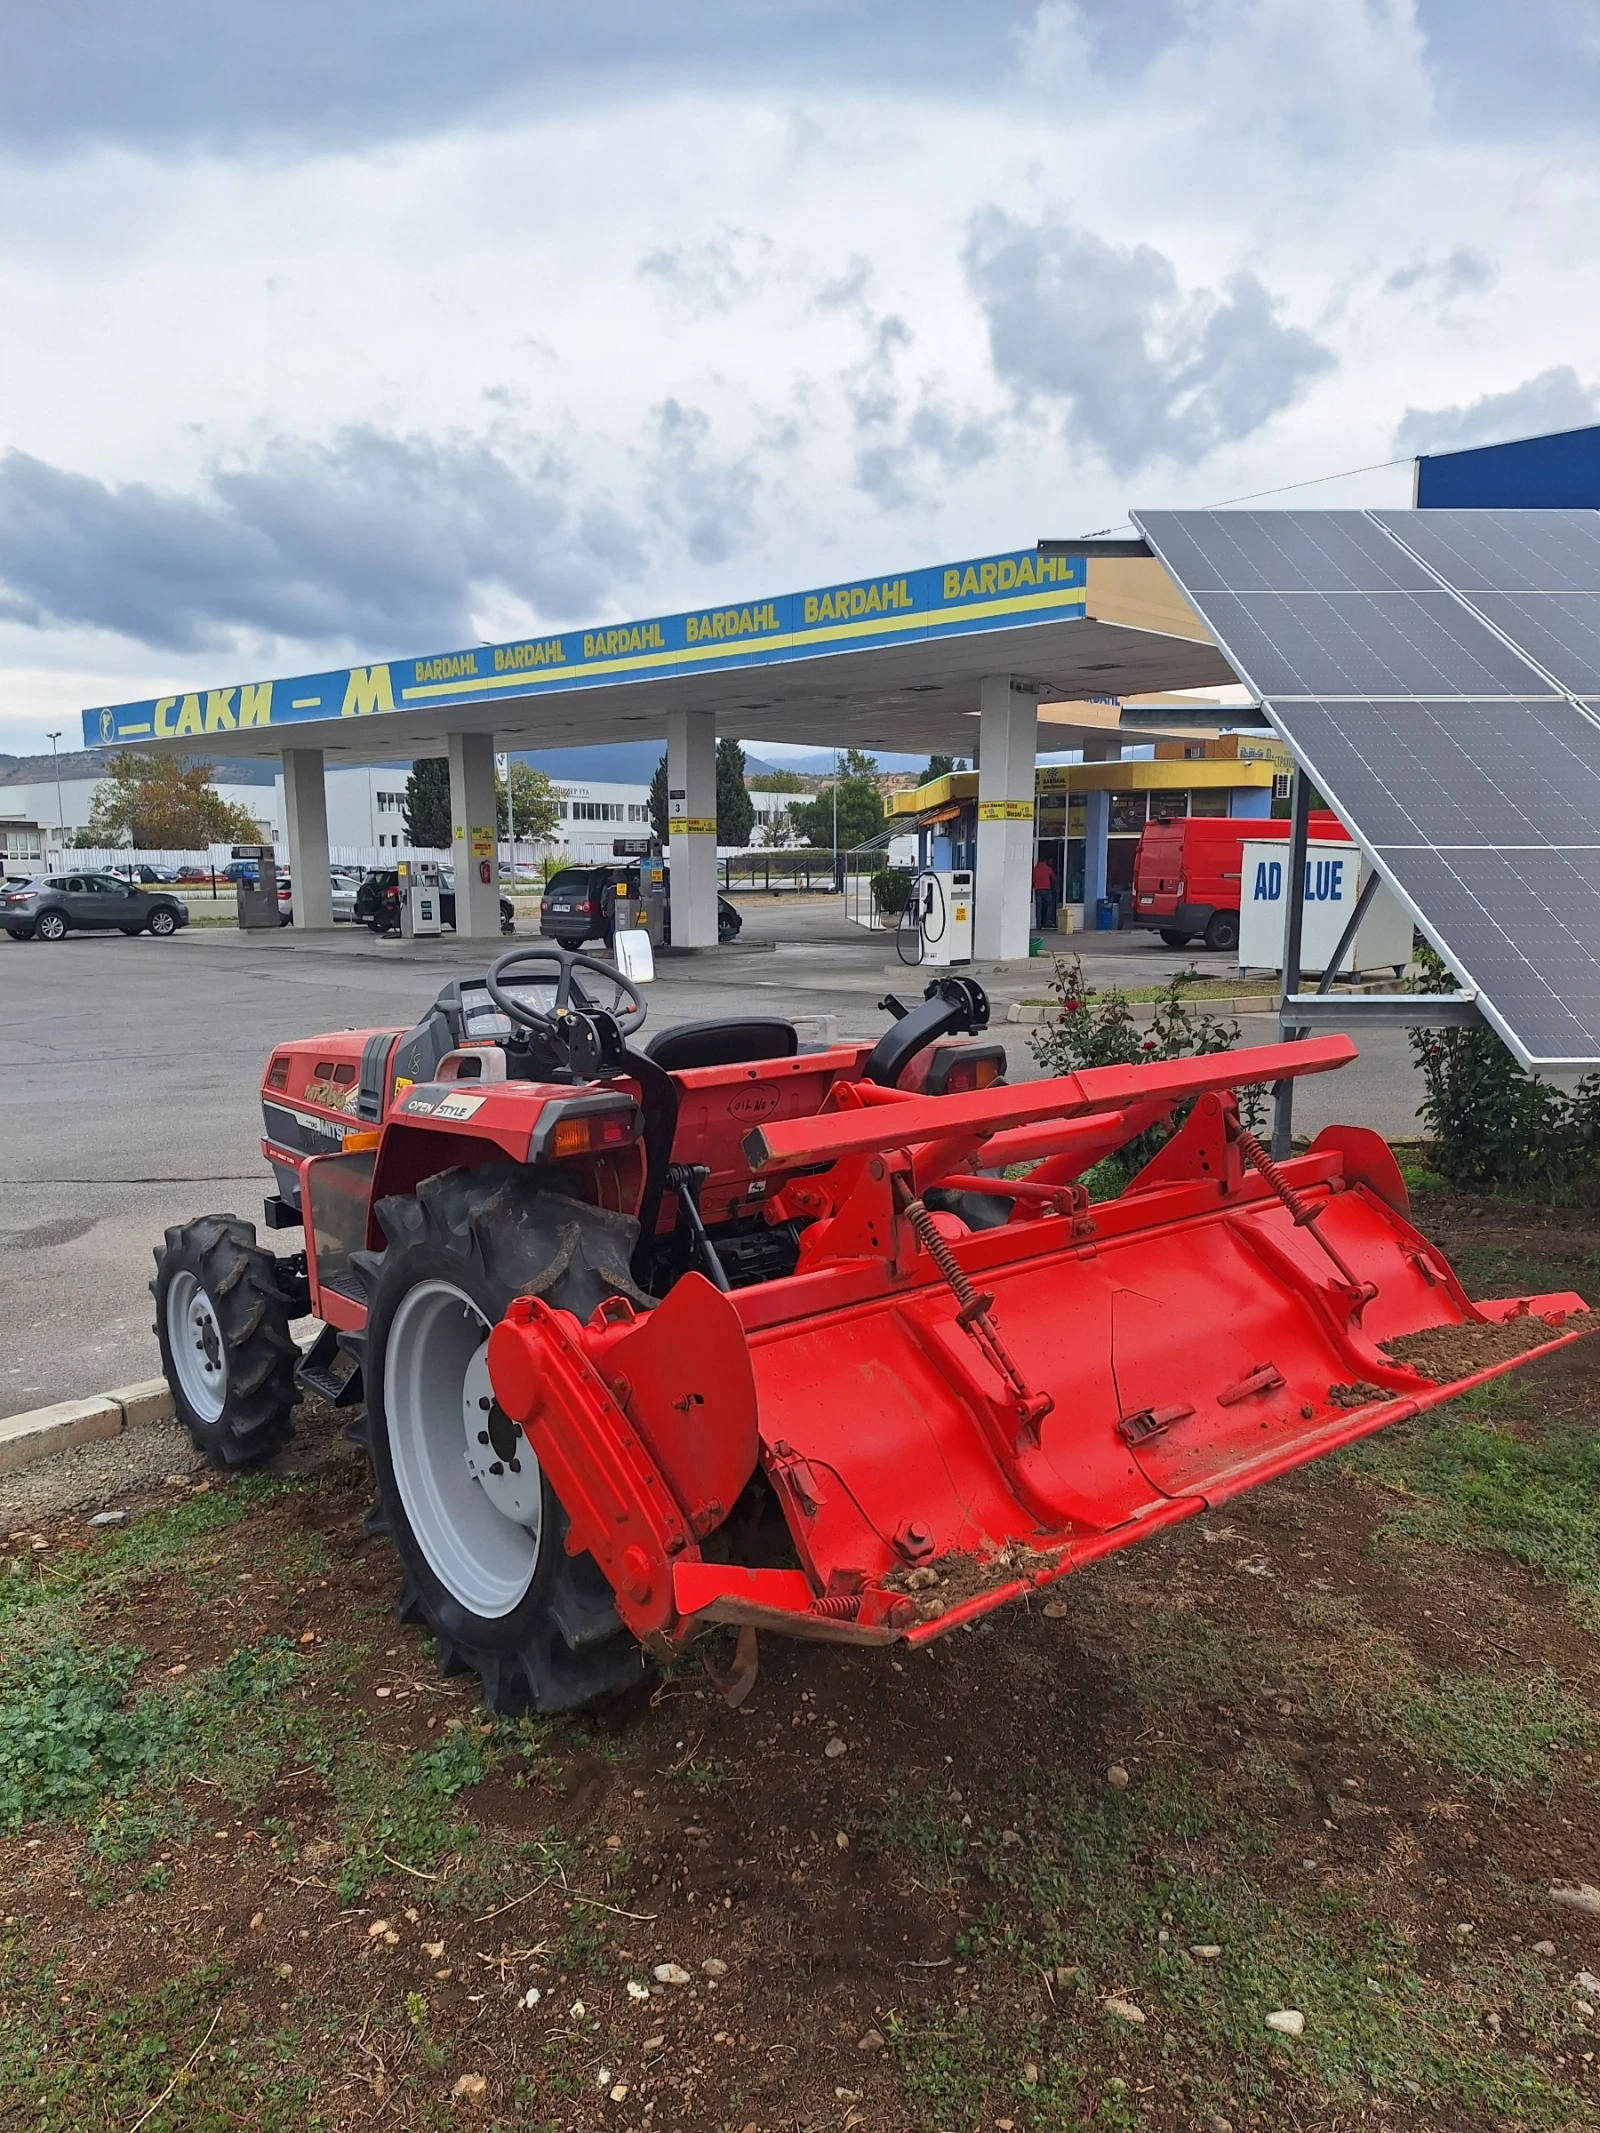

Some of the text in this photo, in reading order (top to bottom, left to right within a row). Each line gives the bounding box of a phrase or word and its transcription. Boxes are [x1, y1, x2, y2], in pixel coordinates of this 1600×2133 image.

[943, 557, 1075, 599] BARDAHL
[803, 579, 913, 624] BARDAHL
[685, 603, 780, 643] BARDAHL
[494, 640, 566, 672] BARDAHL
[583, 623, 665, 658] BARDAHL
[415, 653, 479, 683] BARDAHL
[154, 682, 274, 738] САКИ
[341, 664, 397, 716] М
[1084, 696, 1120, 707] DAHL
[675, 803, 681, 813] 3
[1254, 860, 1344, 902] AD LUE
[408, 1100, 467, 1117] OPEN STYLE
[734, 1099, 752, 1111] OIL
[320, 1119, 360, 1141] MITSU
